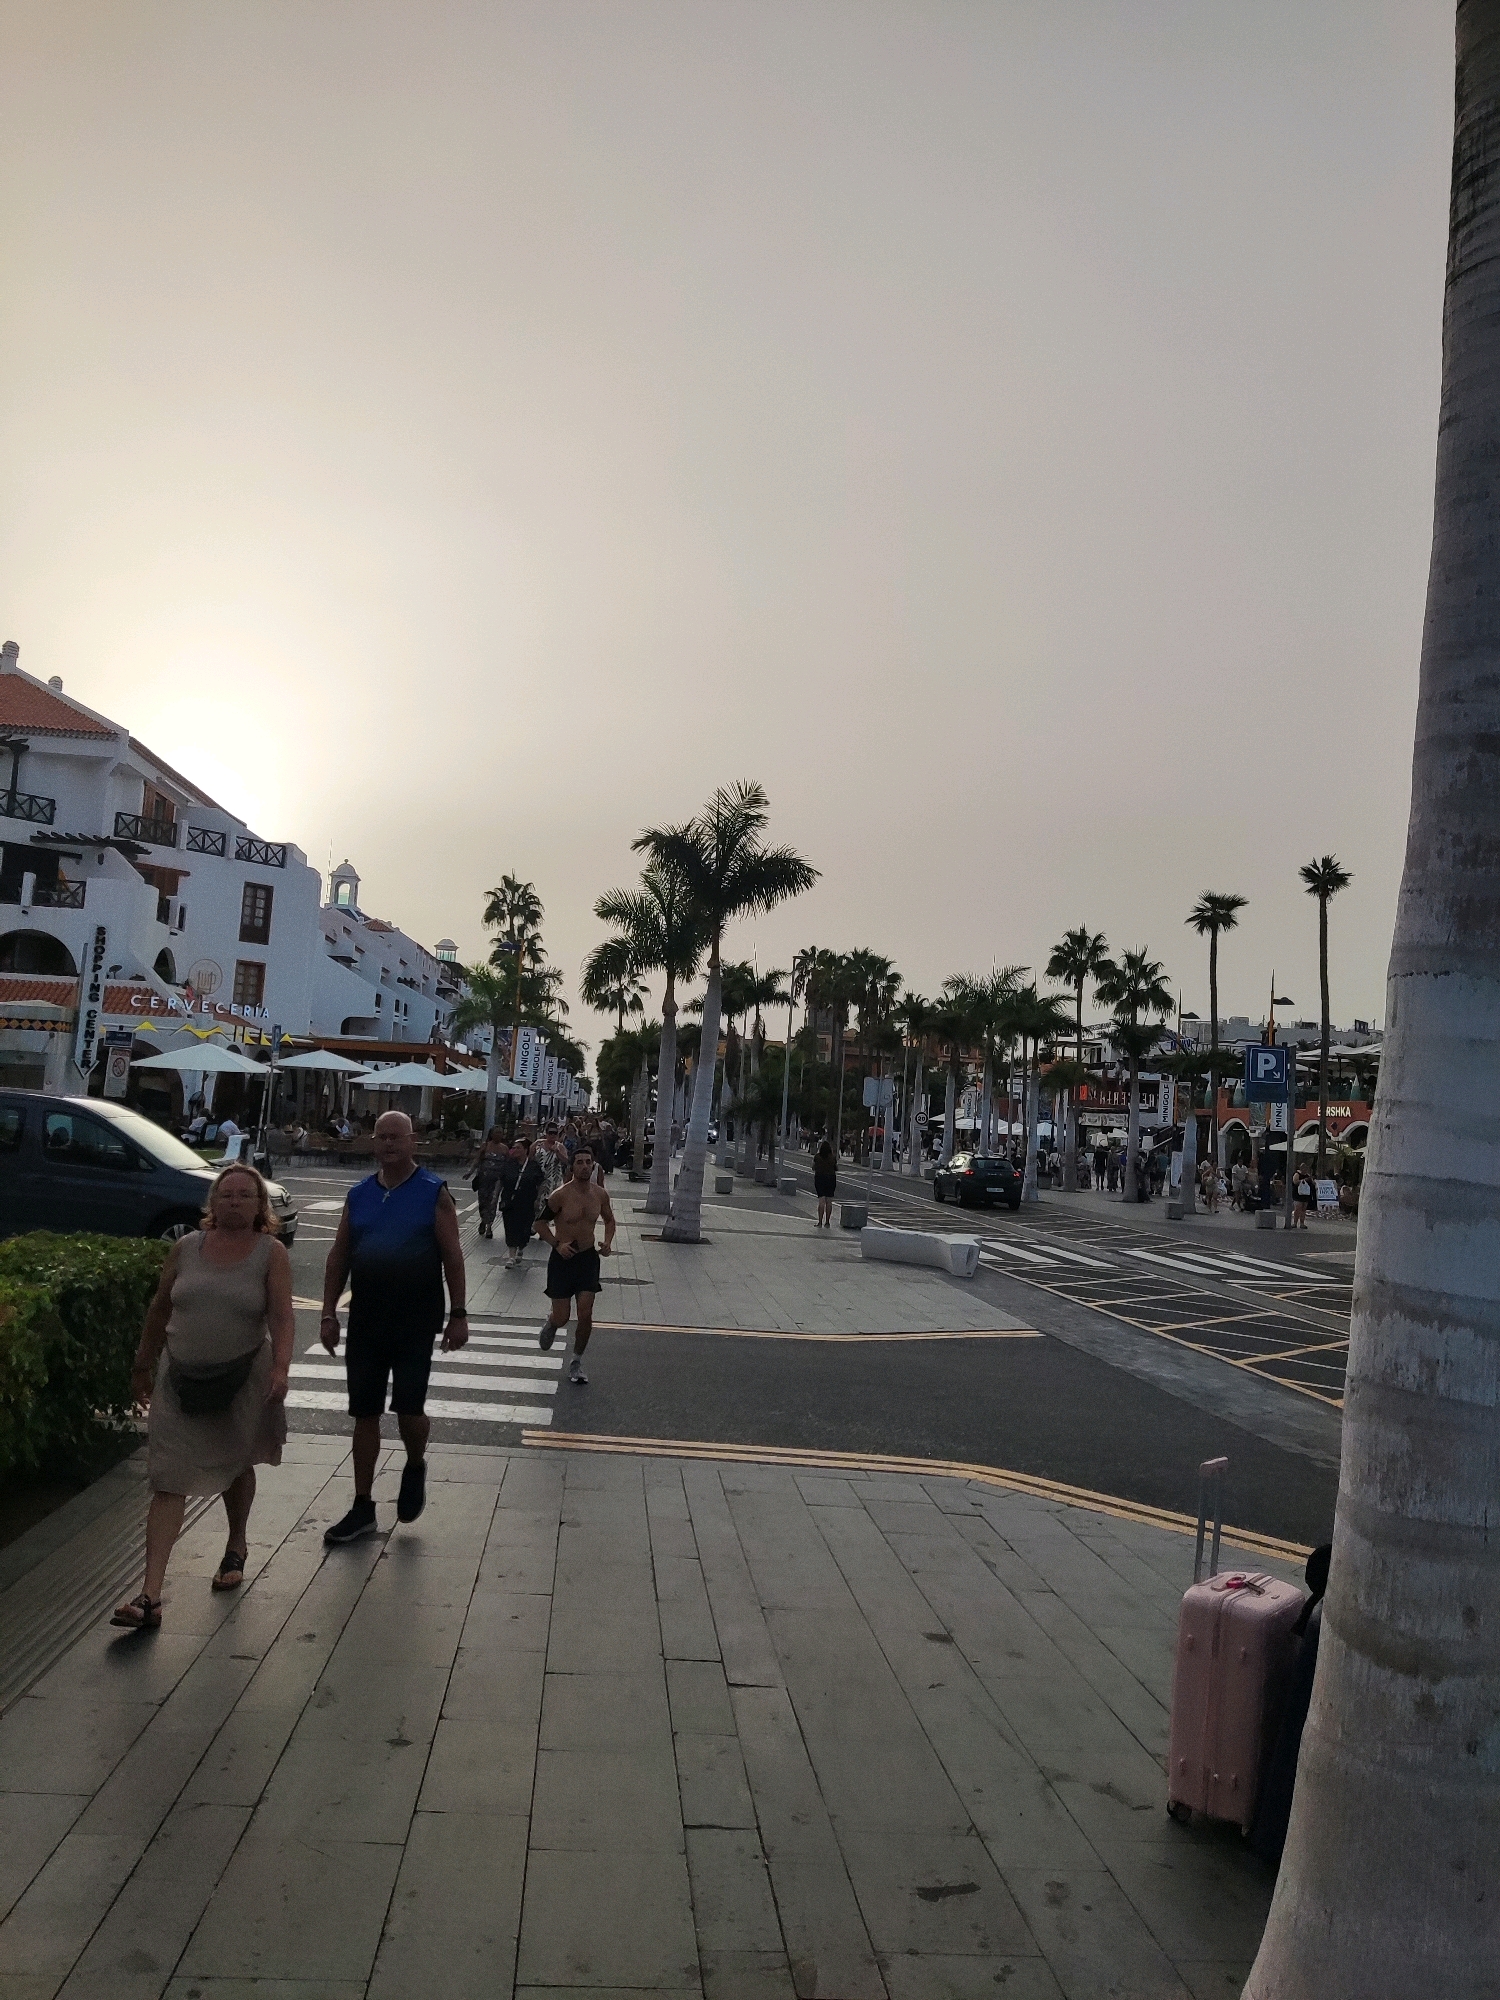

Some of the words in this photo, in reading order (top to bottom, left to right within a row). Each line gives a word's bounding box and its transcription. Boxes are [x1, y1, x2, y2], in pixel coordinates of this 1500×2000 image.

[89, 926, 107, 1002] SHOPPING
[131, 994, 270, 1019] CERVECERÍA
[80, 1010, 97, 1068] CENTER
[519, 1031, 531, 1077] MINIGOLF
[531, 1046, 541, 1086] MINIGOLF
[546, 1059, 554, 1091] MINIGOLF
[1257, 1052, 1277, 1079] P
[1162, 1084, 1170, 1123] MINIGOLF
[1317, 1106, 1352, 1118] BRSHKA
